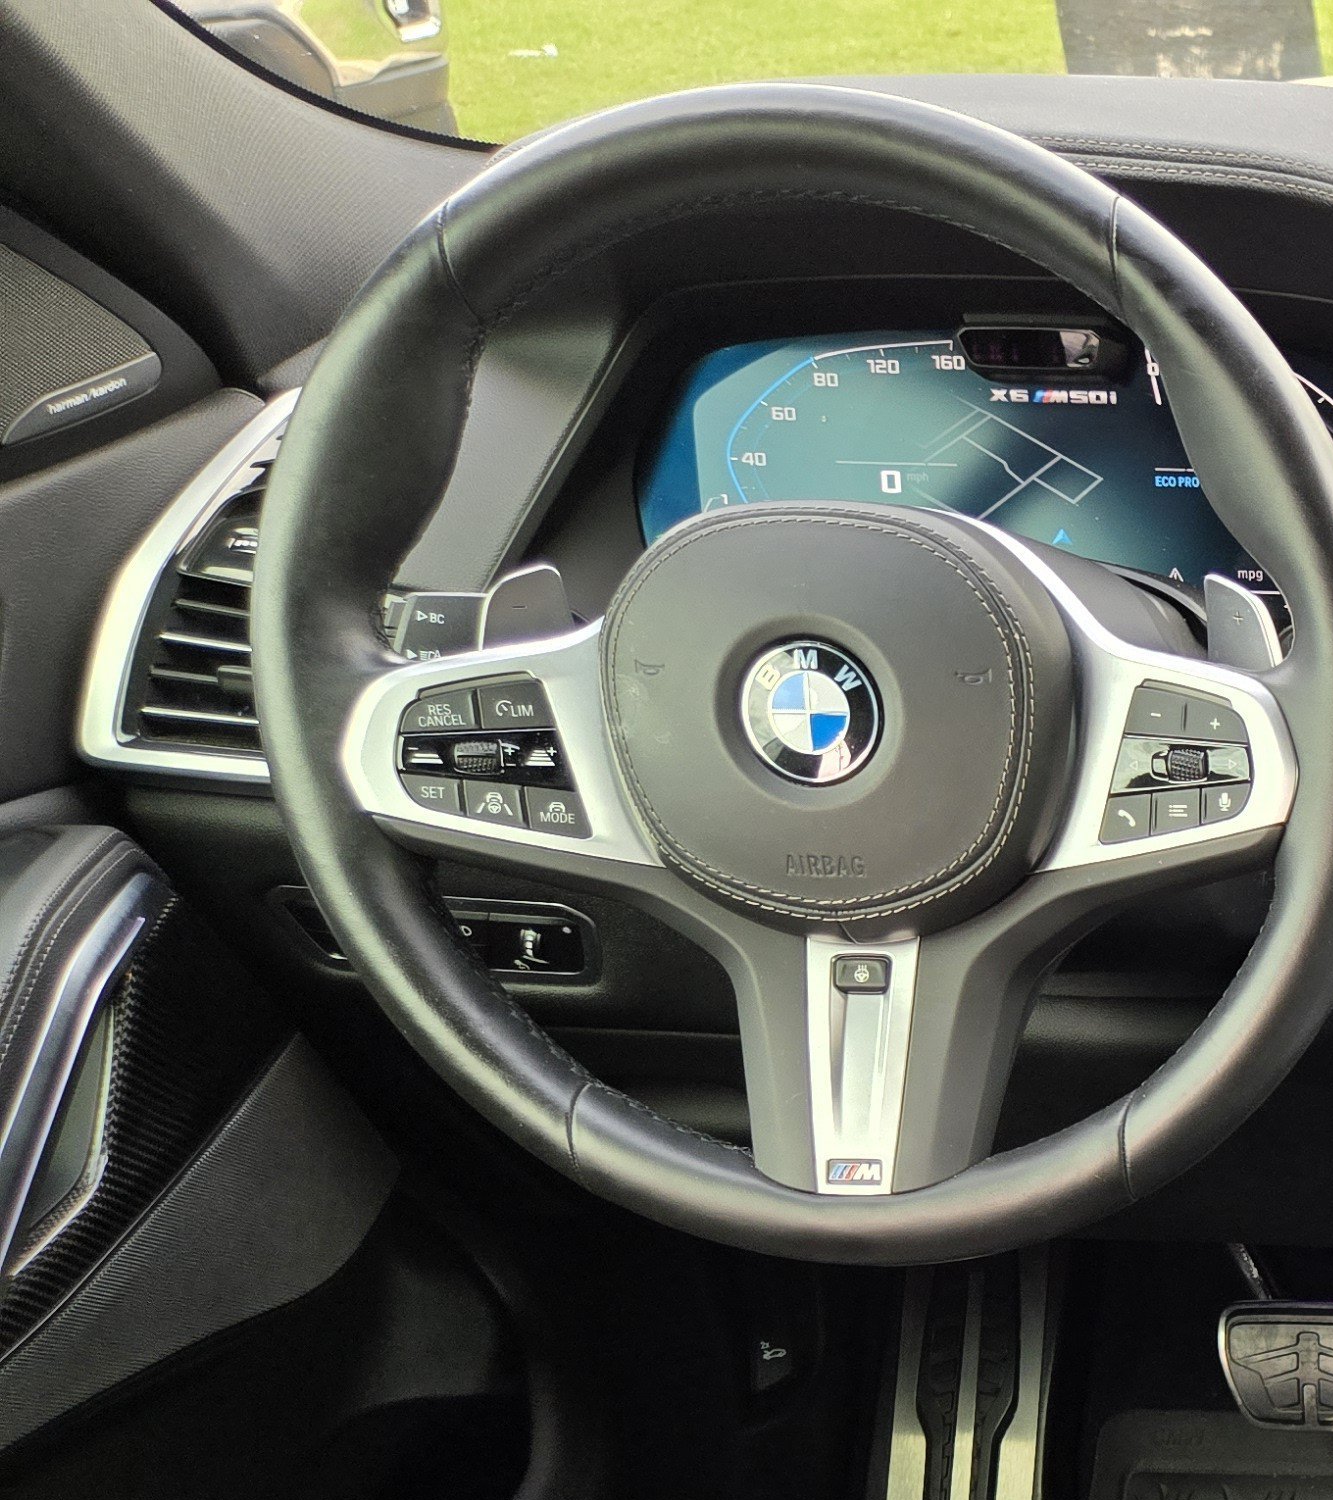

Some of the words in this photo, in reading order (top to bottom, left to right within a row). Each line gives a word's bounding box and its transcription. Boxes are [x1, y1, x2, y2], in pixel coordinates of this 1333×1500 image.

[867, 360, 900, 374] 120
[931, 355, 965, 370] 160
[813, 373, 838, 387] 80
[989, 389, 1029, 402] X6
[771, 407, 796, 421] 60
[741, 452, 767, 466] 40
[880, 470, 902, 493] 0
[906, 472, 929, 483] mph
[1155, 476, 1176, 487] ECO
[1178, 477, 1200, 488] PRO
[1237, 569, 1264, 582] mpg
[430, 613, 445, 624] BC
[755, 649, 862, 692] BMW
[428, 704, 451, 716] RES
[511, 705, 534, 717] LIM
[418, 714, 466, 727] CANCEL
[421, 786, 444, 799] SET
[540, 809, 575, 824] MODE
[786, 854, 866, 877] AIRBAG
